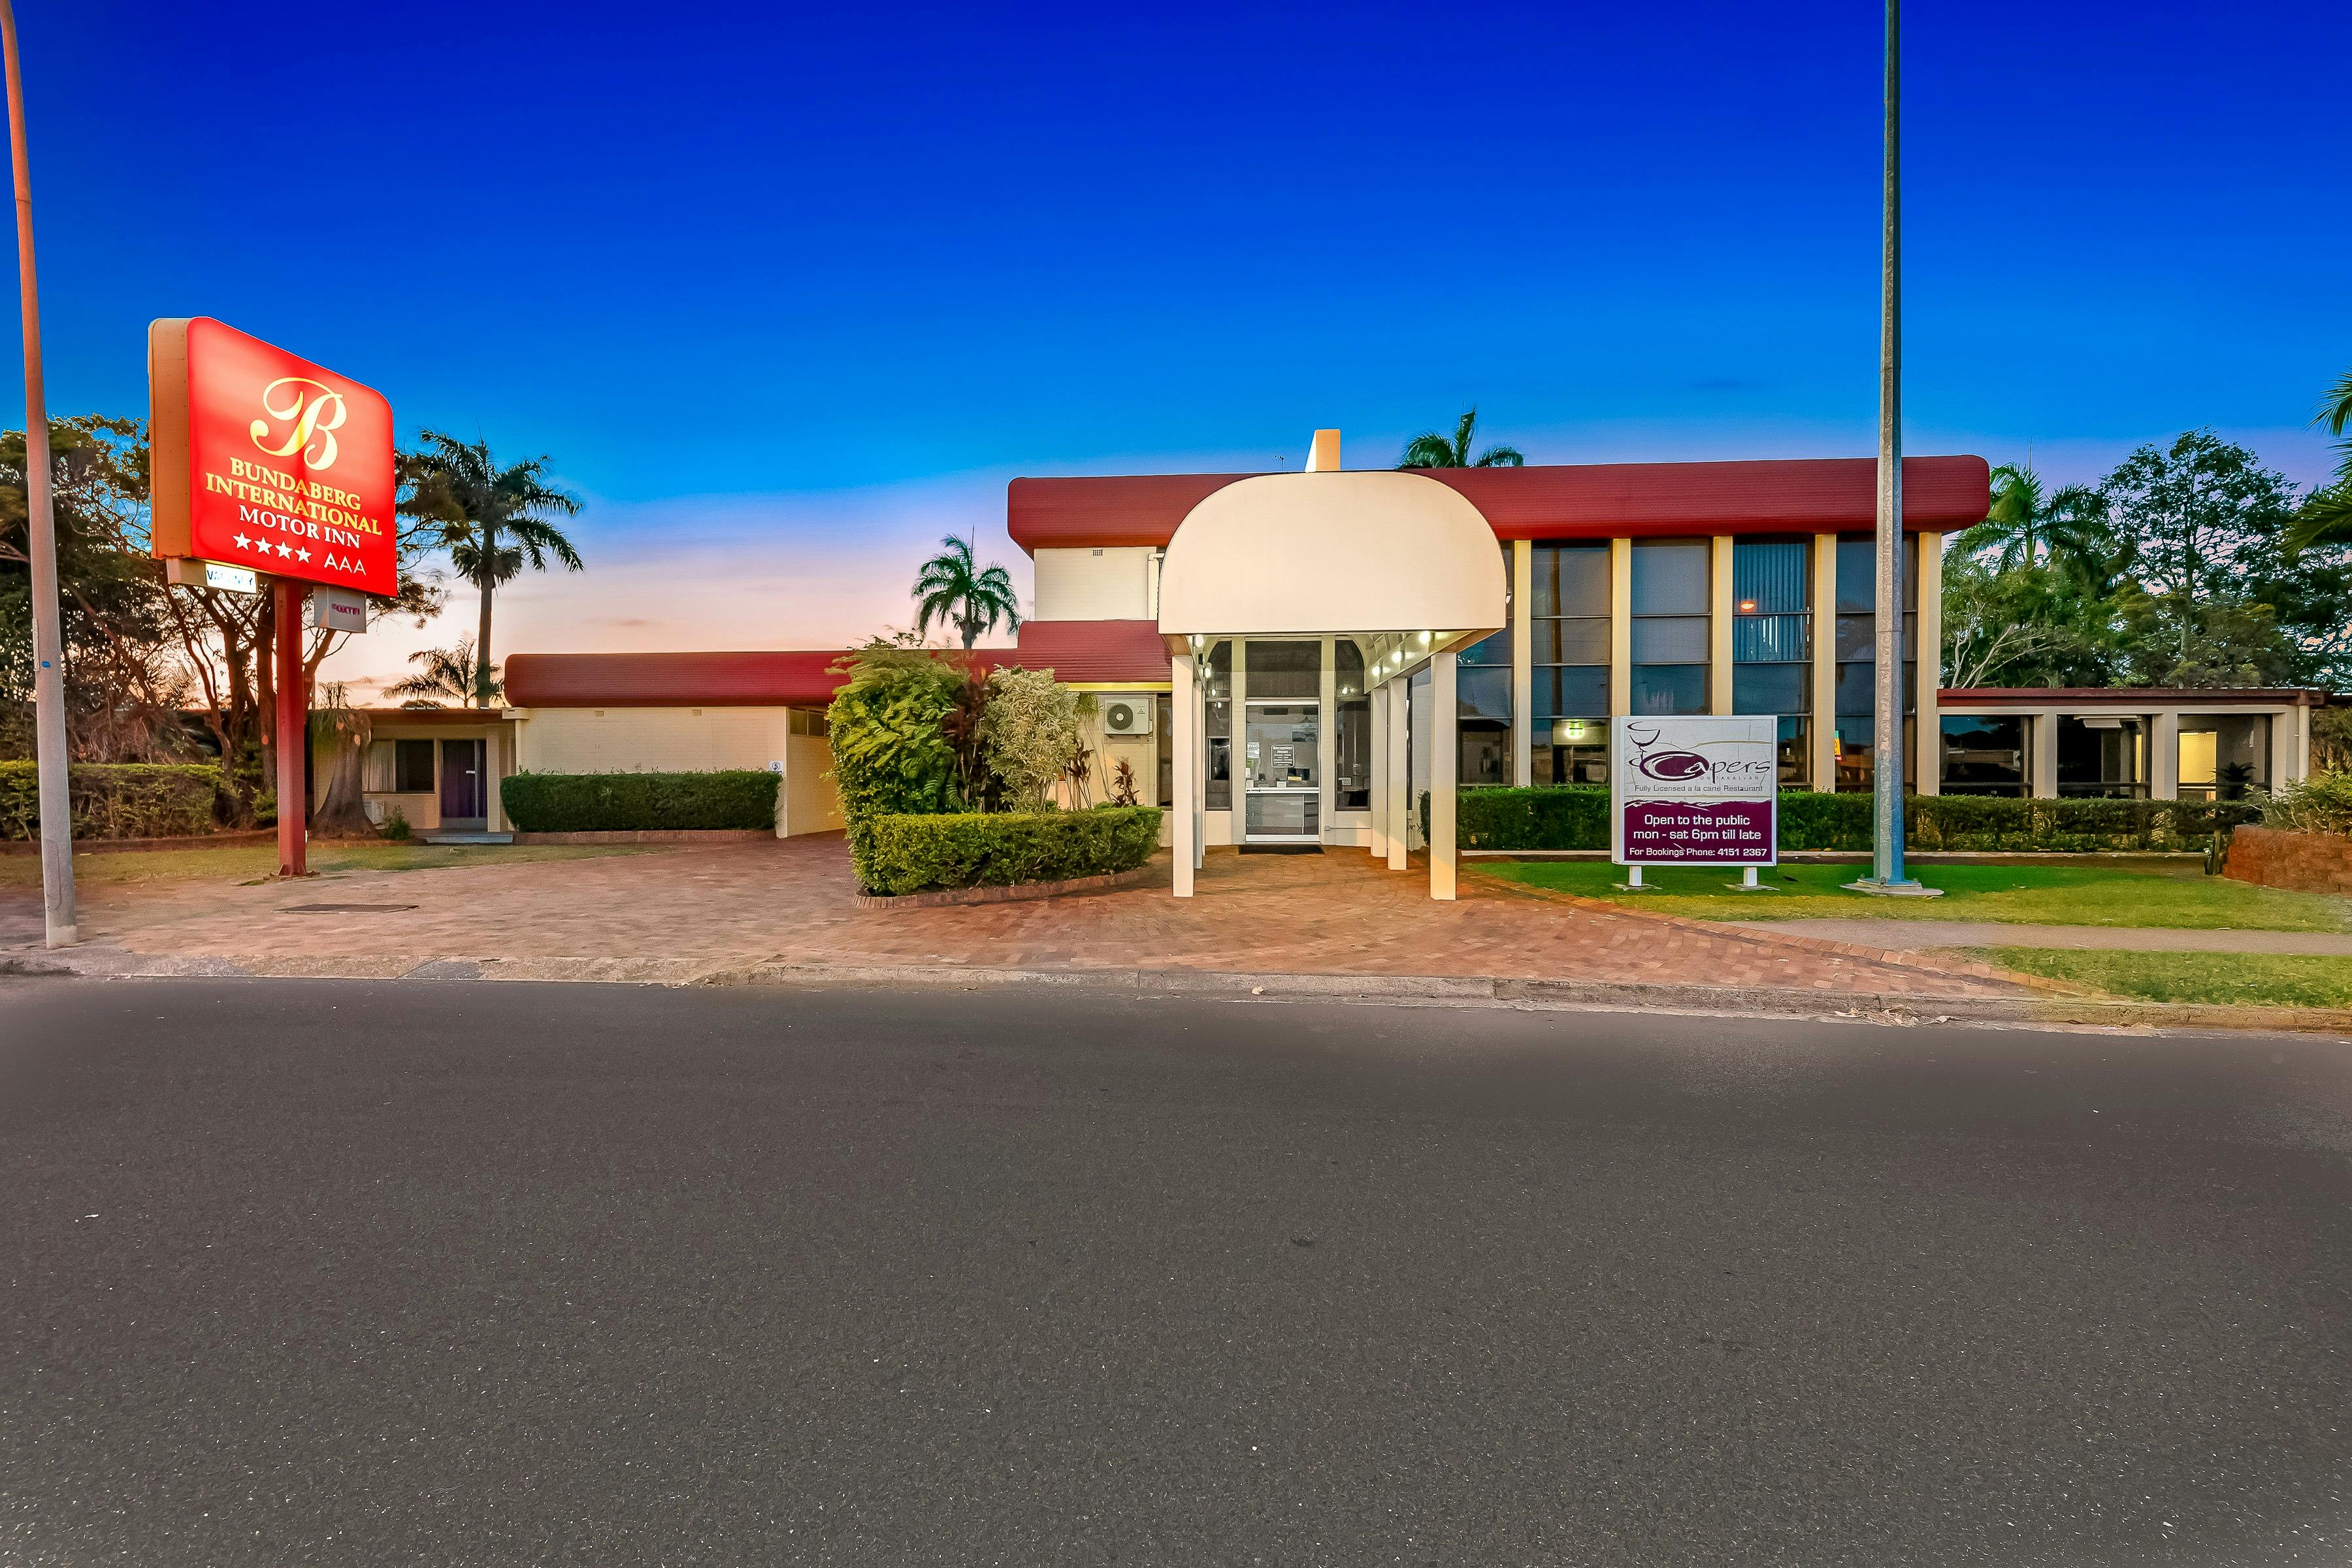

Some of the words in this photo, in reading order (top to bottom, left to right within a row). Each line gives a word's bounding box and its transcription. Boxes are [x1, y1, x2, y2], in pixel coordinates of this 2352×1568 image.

[250, 377, 347, 471] B
[230, 457, 361, 511] BUNDABERG
[206, 472, 382, 536] INTERNATIONAL
[239, 504, 320, 540] MOTOR
[324, 526, 361, 549] INN
[323, 552, 367, 576] AAA
[1639, 751, 1771, 784] Capers
[1633, 830, 1659, 840] mon
[1669, 830, 1689, 840] sat
[1691, 829, 1719, 841] 6pm
[1722, 830, 1735, 840] till
[1739, 830, 1761, 840] late
[1644, 814, 1674, 827] Open
[1677, 815, 1690, 825] to
[1693, 815, 1712, 825] the
[1716, 815, 1750, 827] public
[1629, 847, 1644, 856] For
[1646, 847, 1684, 858] Bookings
